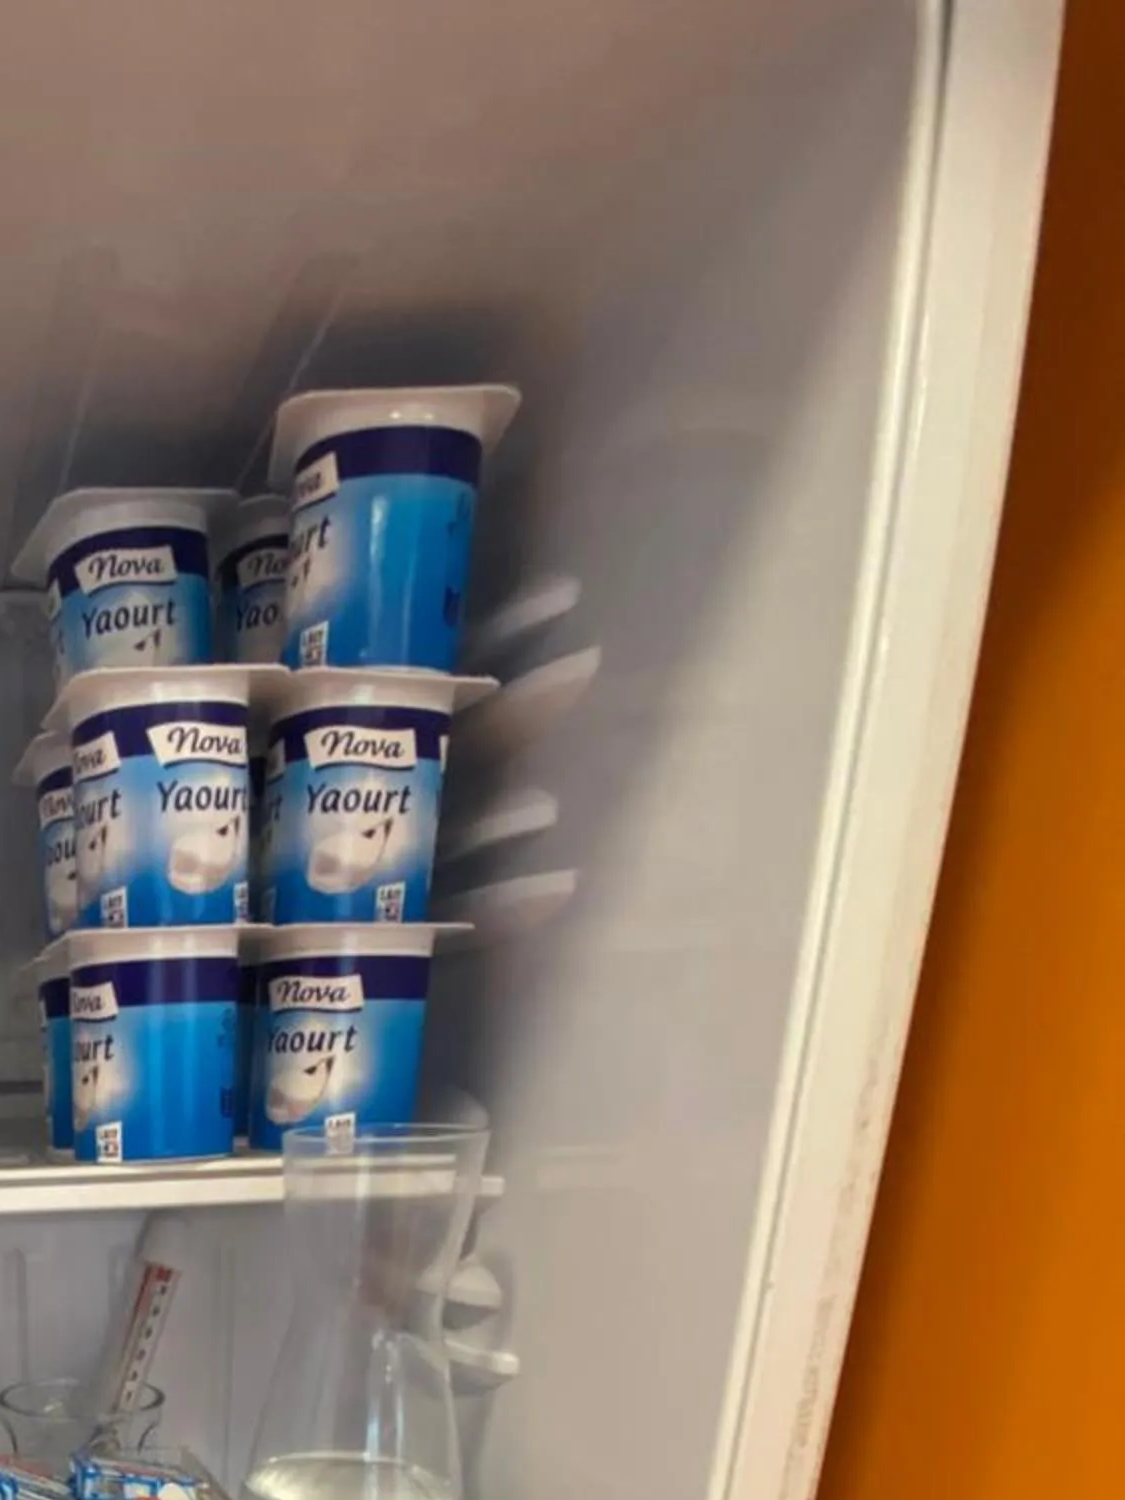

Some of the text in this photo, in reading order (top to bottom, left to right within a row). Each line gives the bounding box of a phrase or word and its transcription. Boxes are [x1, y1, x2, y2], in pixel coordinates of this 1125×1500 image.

[88, 554, 164, 581] Nova
[248, 551, 286, 576] No
[81, 597, 176, 639] Yaourt
[236, 602, 280, 633] Yao
[167, 726, 243, 755] Nova
[320, 730, 407, 759] Nova
[306, 783, 413, 816] Yaourt
[276, 980, 352, 1004] Nova
